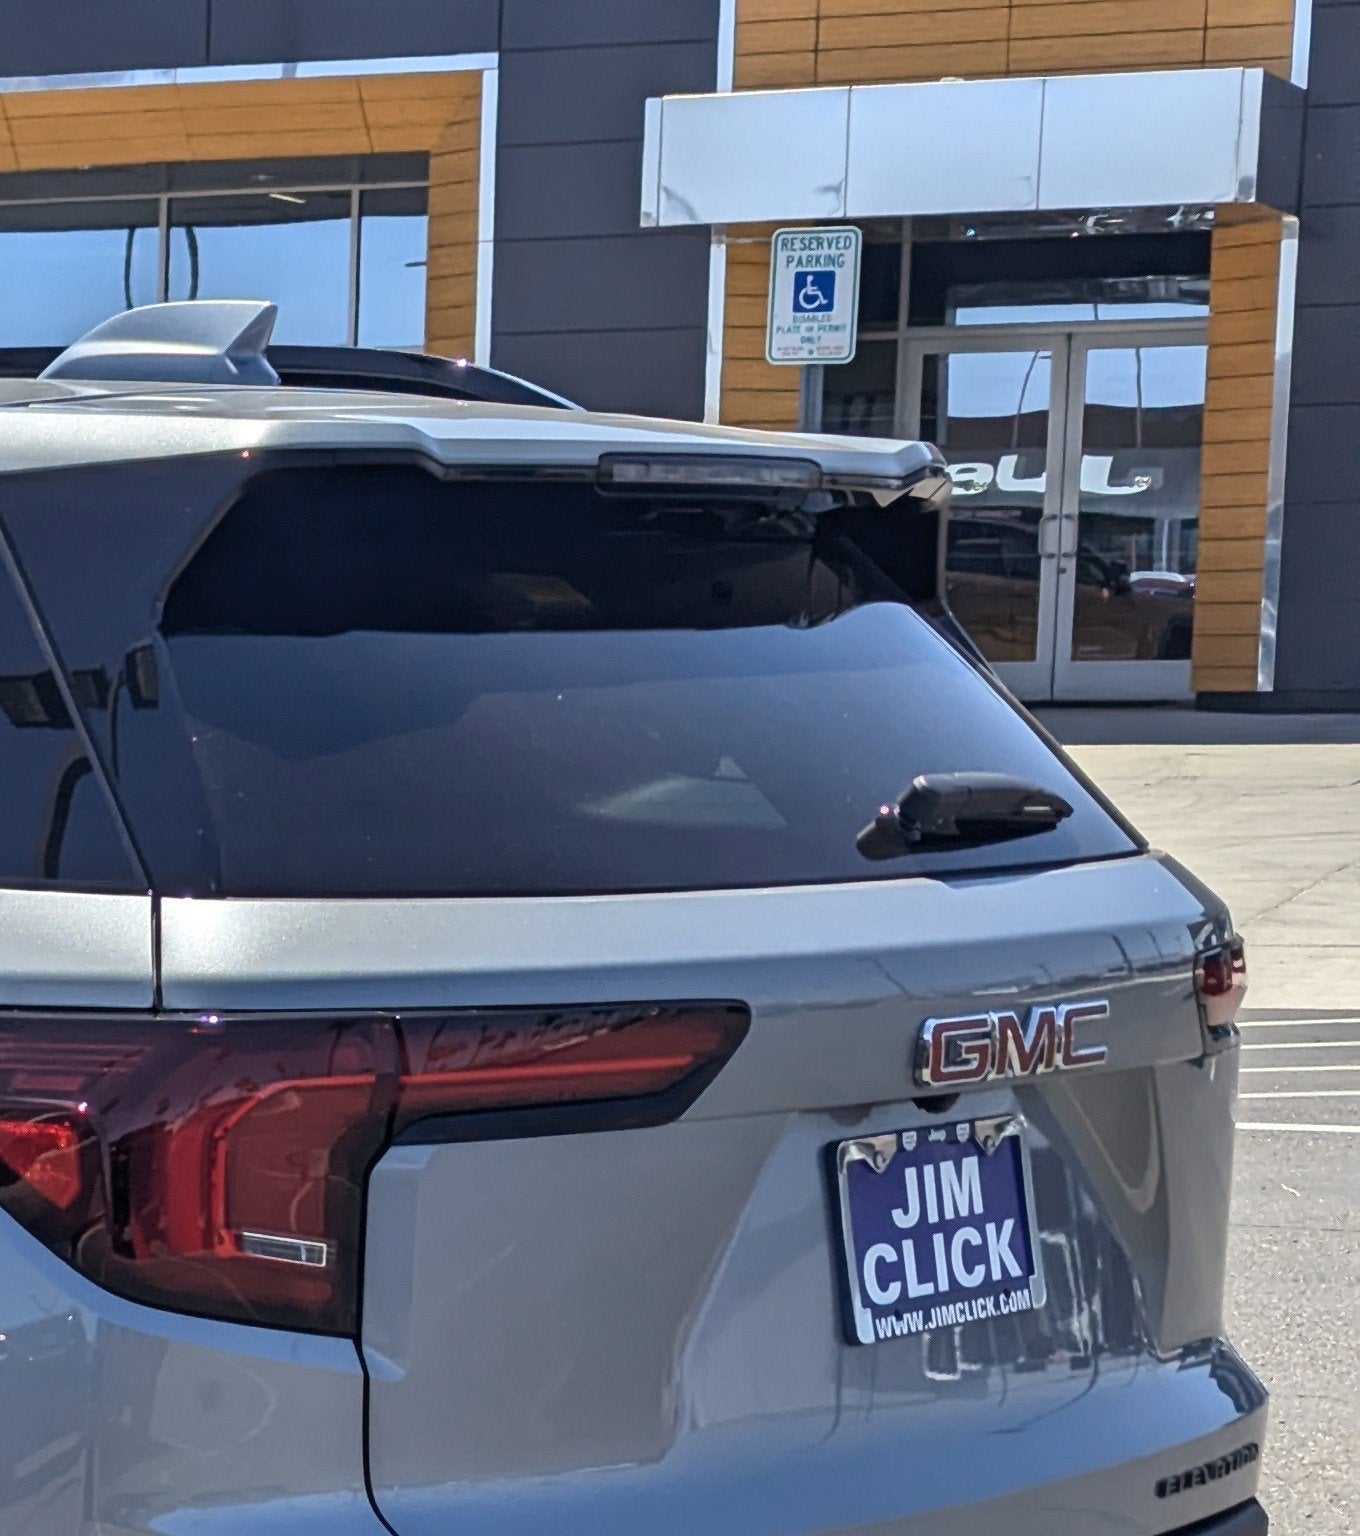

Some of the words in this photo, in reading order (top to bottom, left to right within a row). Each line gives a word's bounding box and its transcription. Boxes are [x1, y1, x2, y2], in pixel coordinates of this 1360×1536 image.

[781, 235, 852, 252] RESERVED
[786, 252, 845, 268] PARKING
[916, 999, 1110, 1086] GMC
[891, 1155, 984, 1229] JIM
[863, 1218, 1023, 1306] CLICK
[875, 1288, 1032, 1340] WWW.JIMCLICK.COM
